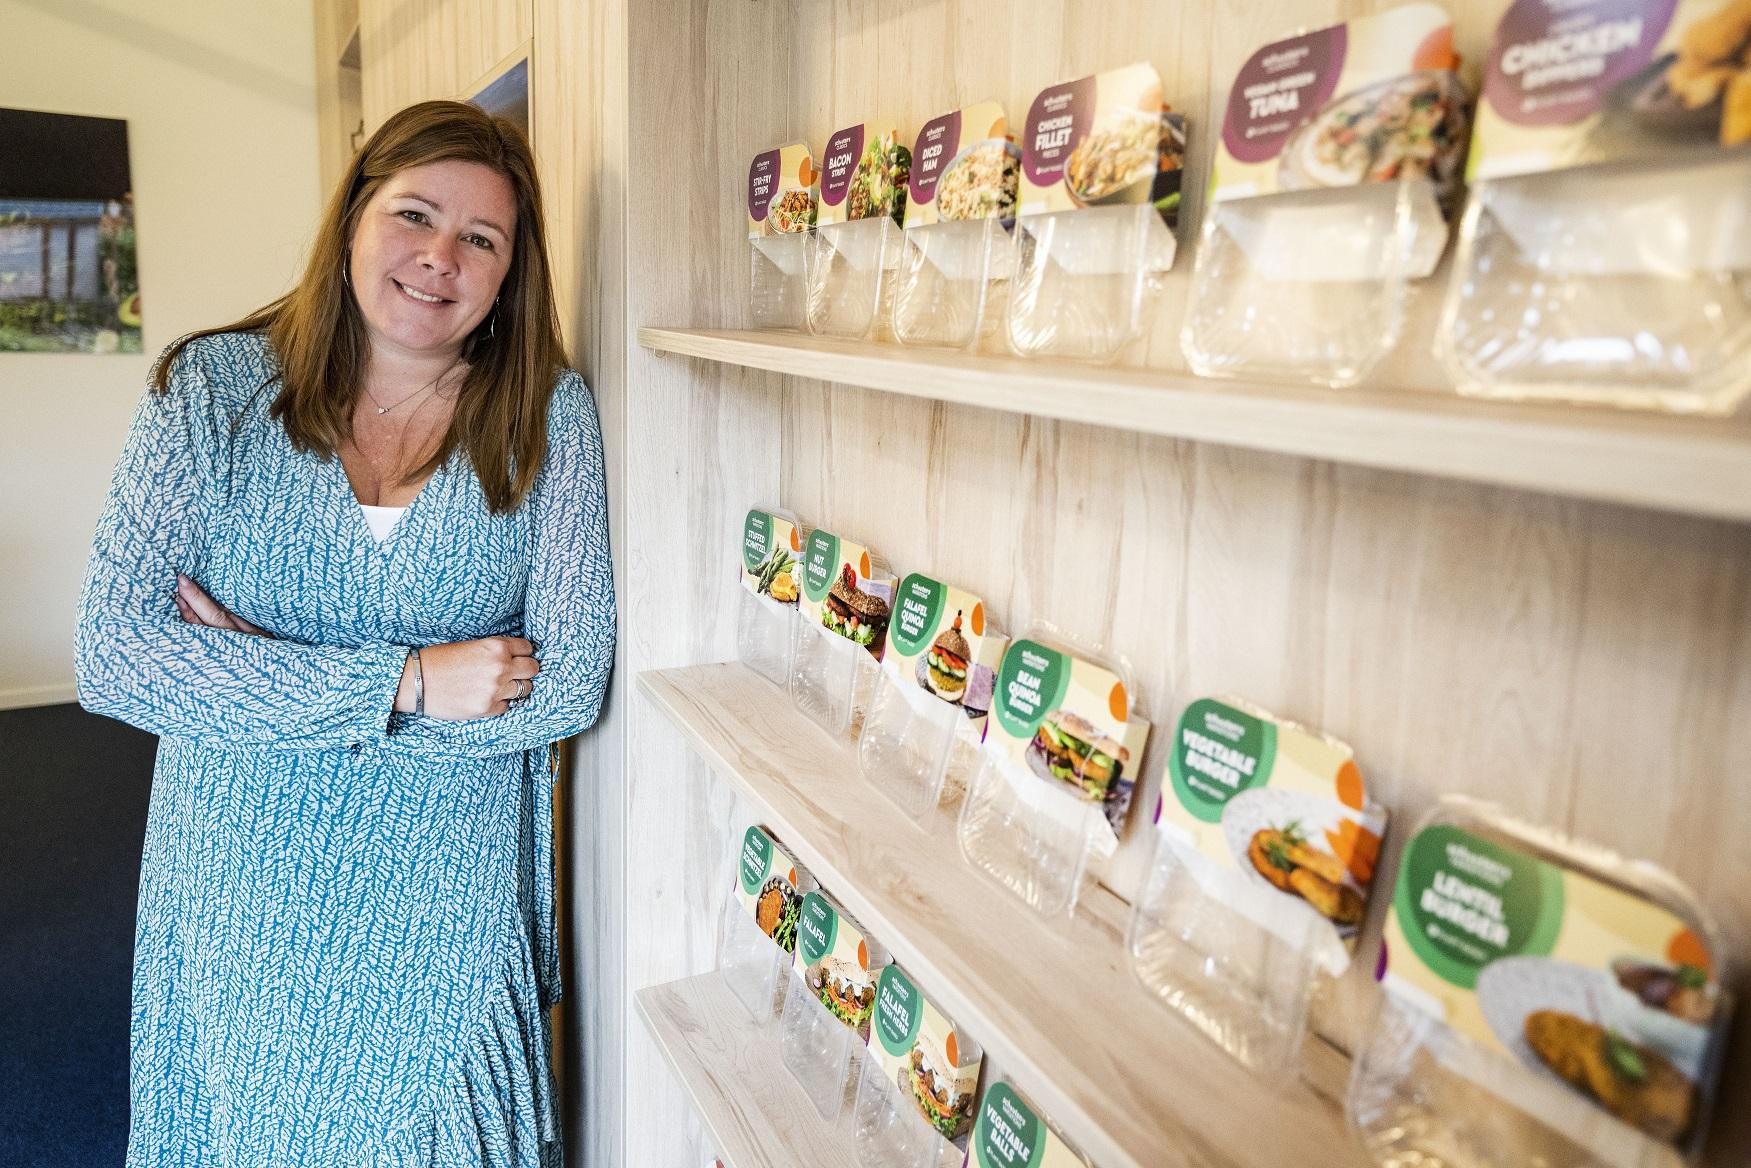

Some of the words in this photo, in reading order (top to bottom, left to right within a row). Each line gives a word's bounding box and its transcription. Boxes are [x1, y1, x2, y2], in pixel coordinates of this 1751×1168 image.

[1501, 17, 1643, 75] CHICKEN
[1249, 89, 1299, 119] TUNA
[1037, 115, 1073, 133] CHICKEN
[1035, 127, 1073, 151] FILLET
[828, 152, 852, 170] BACON
[922, 144, 943, 161] DICED
[831, 167, 846, 178] STRIPS
[922, 158, 938, 172] HAM
[754, 185, 769, 196] STRIPS
[748, 529, 766, 544] STUFFED
[808, 562, 827, 578] BURGER
[814, 553, 825, 566] NUT
[903, 597, 928, 617] FALAFEL
[901, 609, 924, 629] QUINOA
[1017, 669, 1041, 691] BEAN
[1008, 681, 1041, 707] QUINOA
[1183, 728, 1256, 776] VEGETABLE
[1185, 749, 1241, 789] BURGER
[745, 842, 766, 871] VEGETABLE
[803, 915, 826, 947] FALAFEL
[879, 997, 893, 1019] FRESH
[892, 1013, 909, 1037] HERBS
[881, 985, 909, 1028] FALAFEL
[986, 1103, 1030, 1163] VEGETABLE
[990, 1127, 1015, 1163] BALLS
